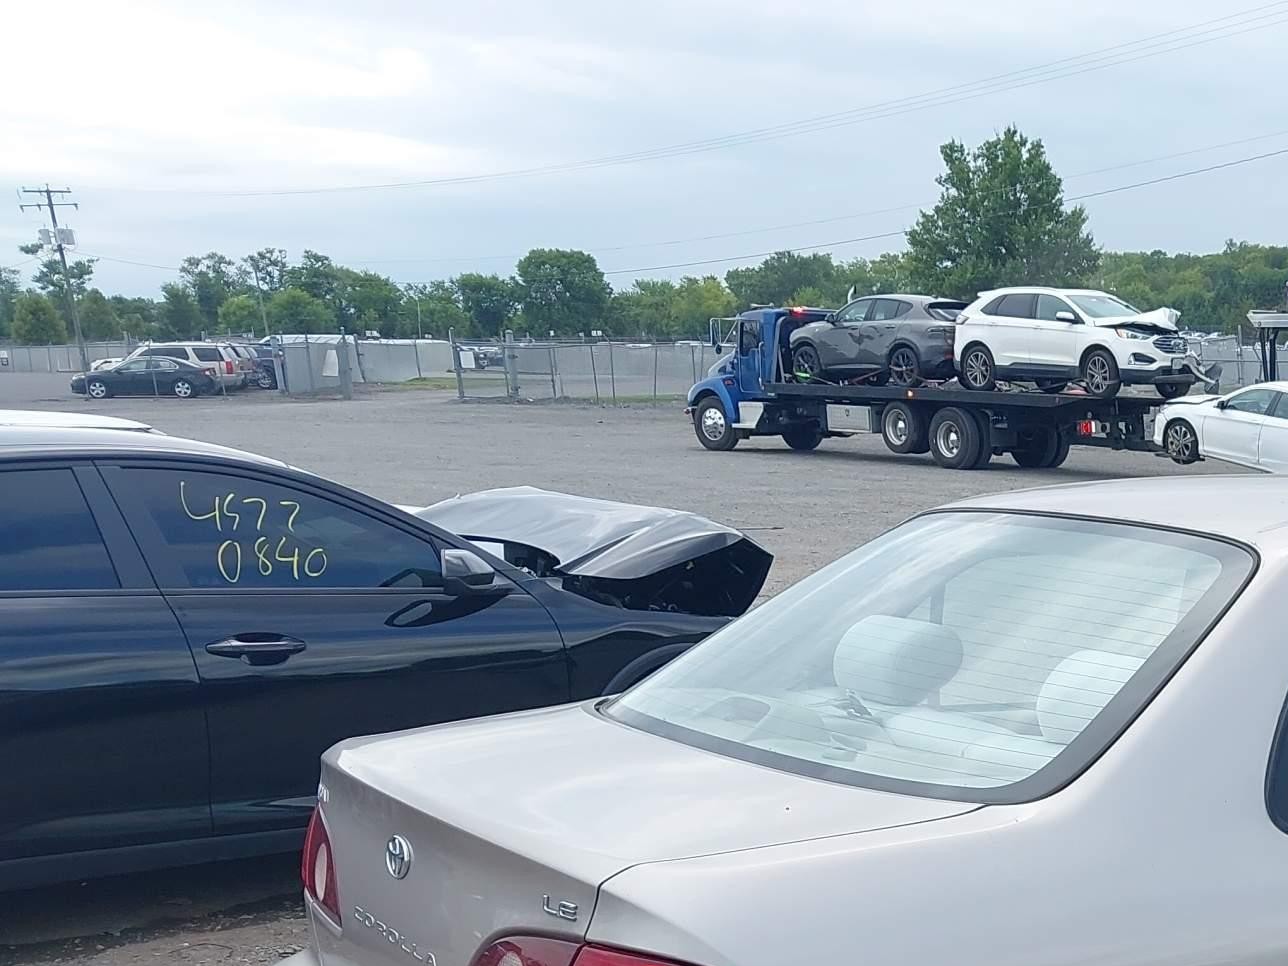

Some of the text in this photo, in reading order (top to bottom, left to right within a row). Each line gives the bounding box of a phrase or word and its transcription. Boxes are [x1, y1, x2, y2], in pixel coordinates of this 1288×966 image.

[180, 481, 300, 532] 4577
[217, 536, 327, 583] 0840
[543, 894, 578, 922] LE
